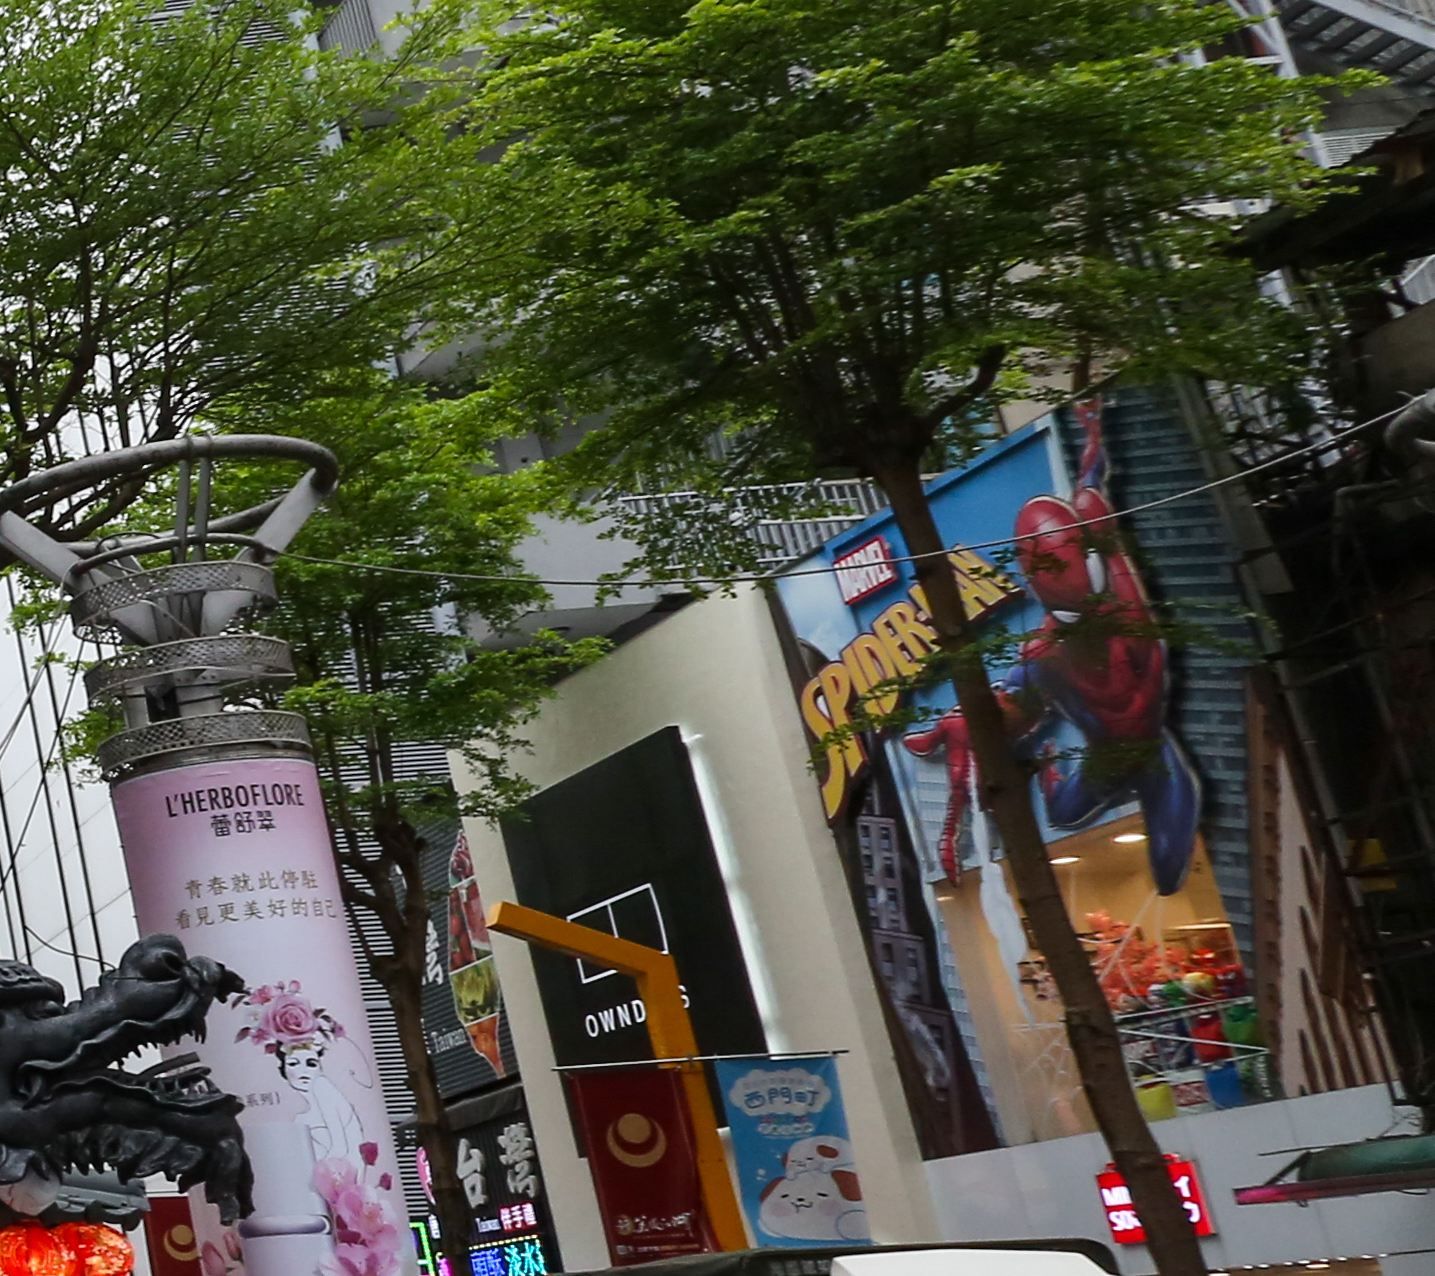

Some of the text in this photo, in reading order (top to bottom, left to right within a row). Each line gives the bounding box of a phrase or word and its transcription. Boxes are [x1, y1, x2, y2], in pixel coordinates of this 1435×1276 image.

[835, 540, 894, 603] MARVEL
[801, 544, 1024, 826] SPIDER-AN
[166, 783, 304, 819] L'HERBOFLORE
[185, 869, 320, 901] 青春就此停駐
[175, 897, 338, 929] 看見更美好的自己
[585, 984, 691, 1038] OWNDS
[431, 1027, 467, 1053] Taiwan
[744, 1086, 820, 1110] 西門町
